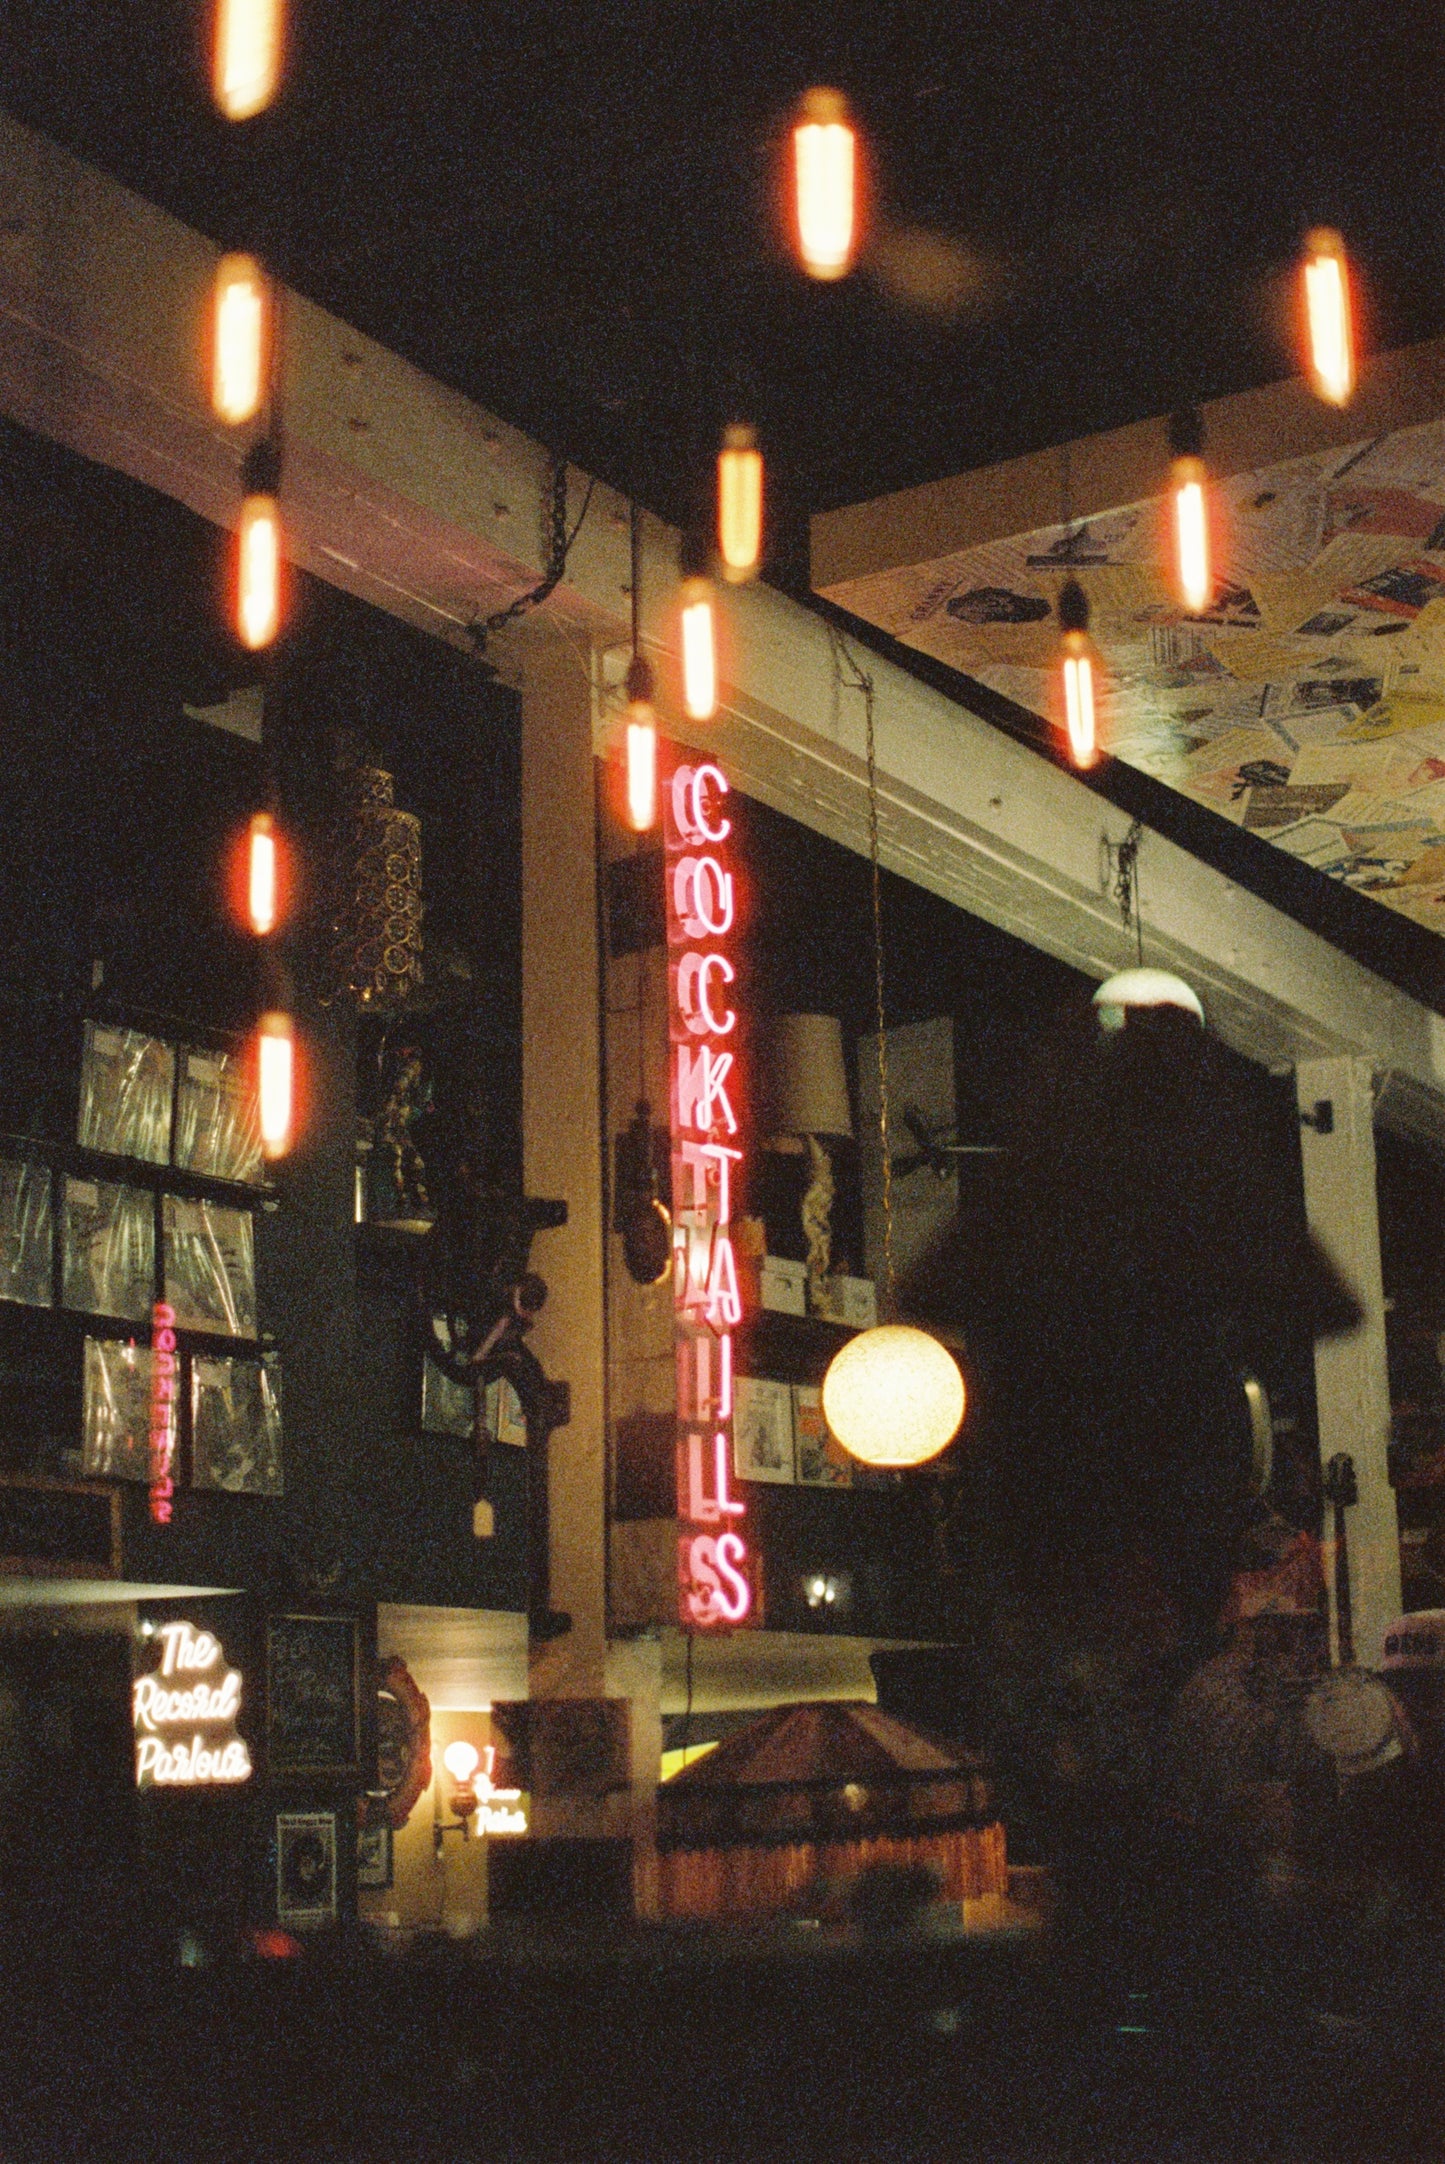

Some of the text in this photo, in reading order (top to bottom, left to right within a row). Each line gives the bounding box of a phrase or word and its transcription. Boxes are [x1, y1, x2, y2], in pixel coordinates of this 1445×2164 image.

[669, 762, 748, 1627] COCKTAILS
[161, 1622, 218, 1675] The
[133, 1672, 240, 1731] Record
[136, 1735, 253, 1788] Parlour
